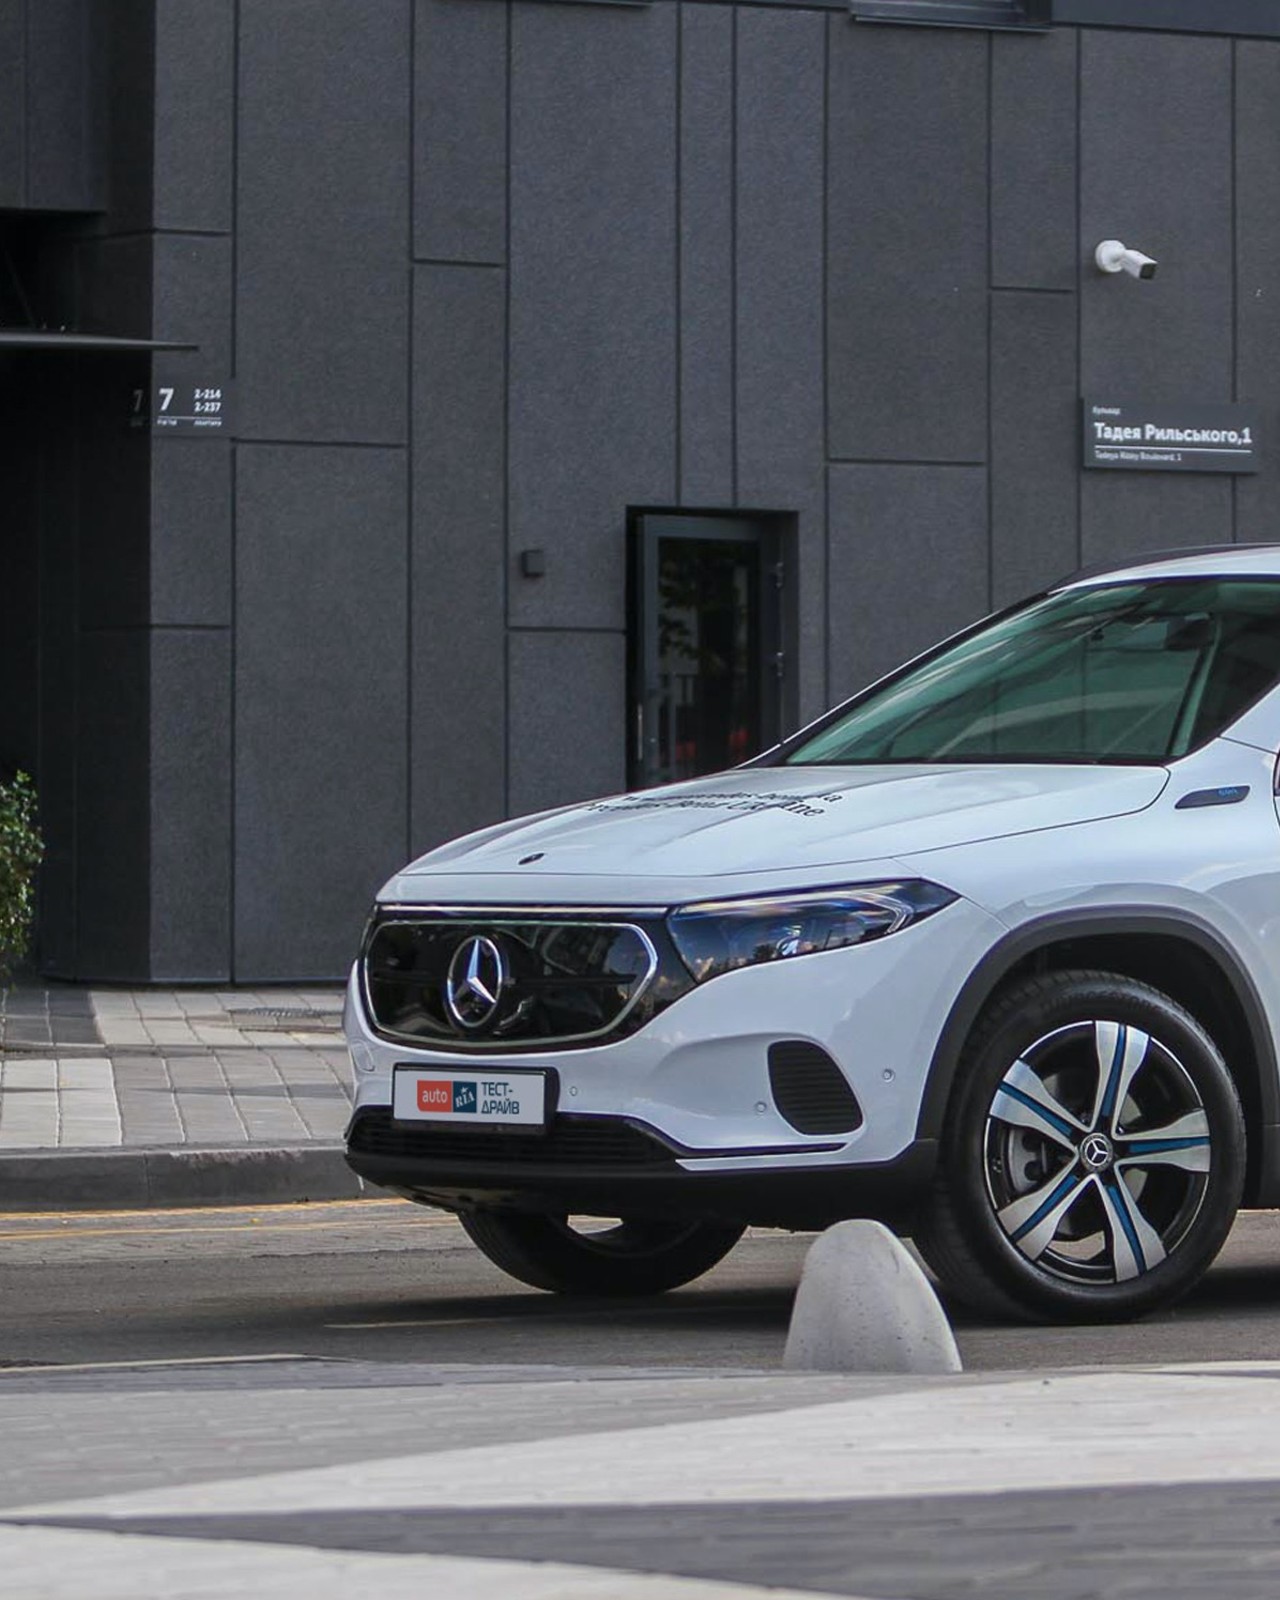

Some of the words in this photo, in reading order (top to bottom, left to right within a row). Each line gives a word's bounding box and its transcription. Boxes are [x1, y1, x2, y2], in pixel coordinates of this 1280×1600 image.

[158, 387, 174, 412] 7
[194, 401, 222, 413] 2-237
[1093, 422, 1142, 442] Тадея
[1145, 424, 1253, 445] Рильського,1
[422, 1089, 448, 1103] auto
[481, 1082, 514, 1096] ТЕСТ-
[481, 1098, 520, 1115] ДРАЙВ
